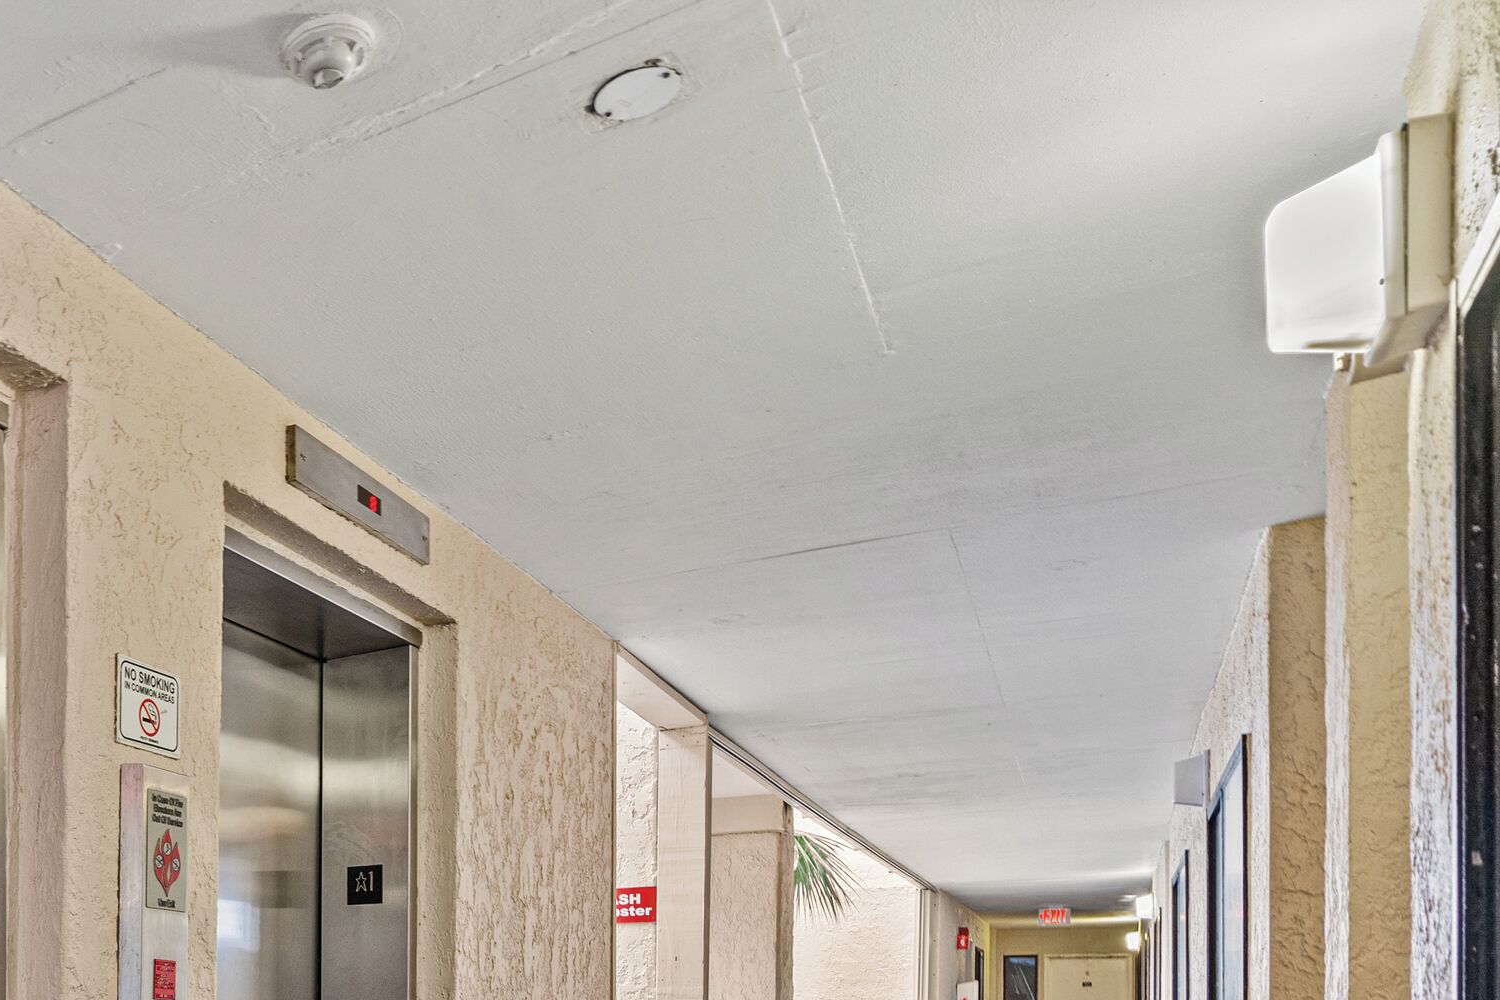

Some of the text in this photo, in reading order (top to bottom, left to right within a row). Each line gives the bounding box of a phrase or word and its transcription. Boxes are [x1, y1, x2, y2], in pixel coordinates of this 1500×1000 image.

[124, 666, 175, 694] NO SMOKING
[124, 680, 175, 704] IN COMMON AREAS
[1043, 907, 1068, 924] EXIT
